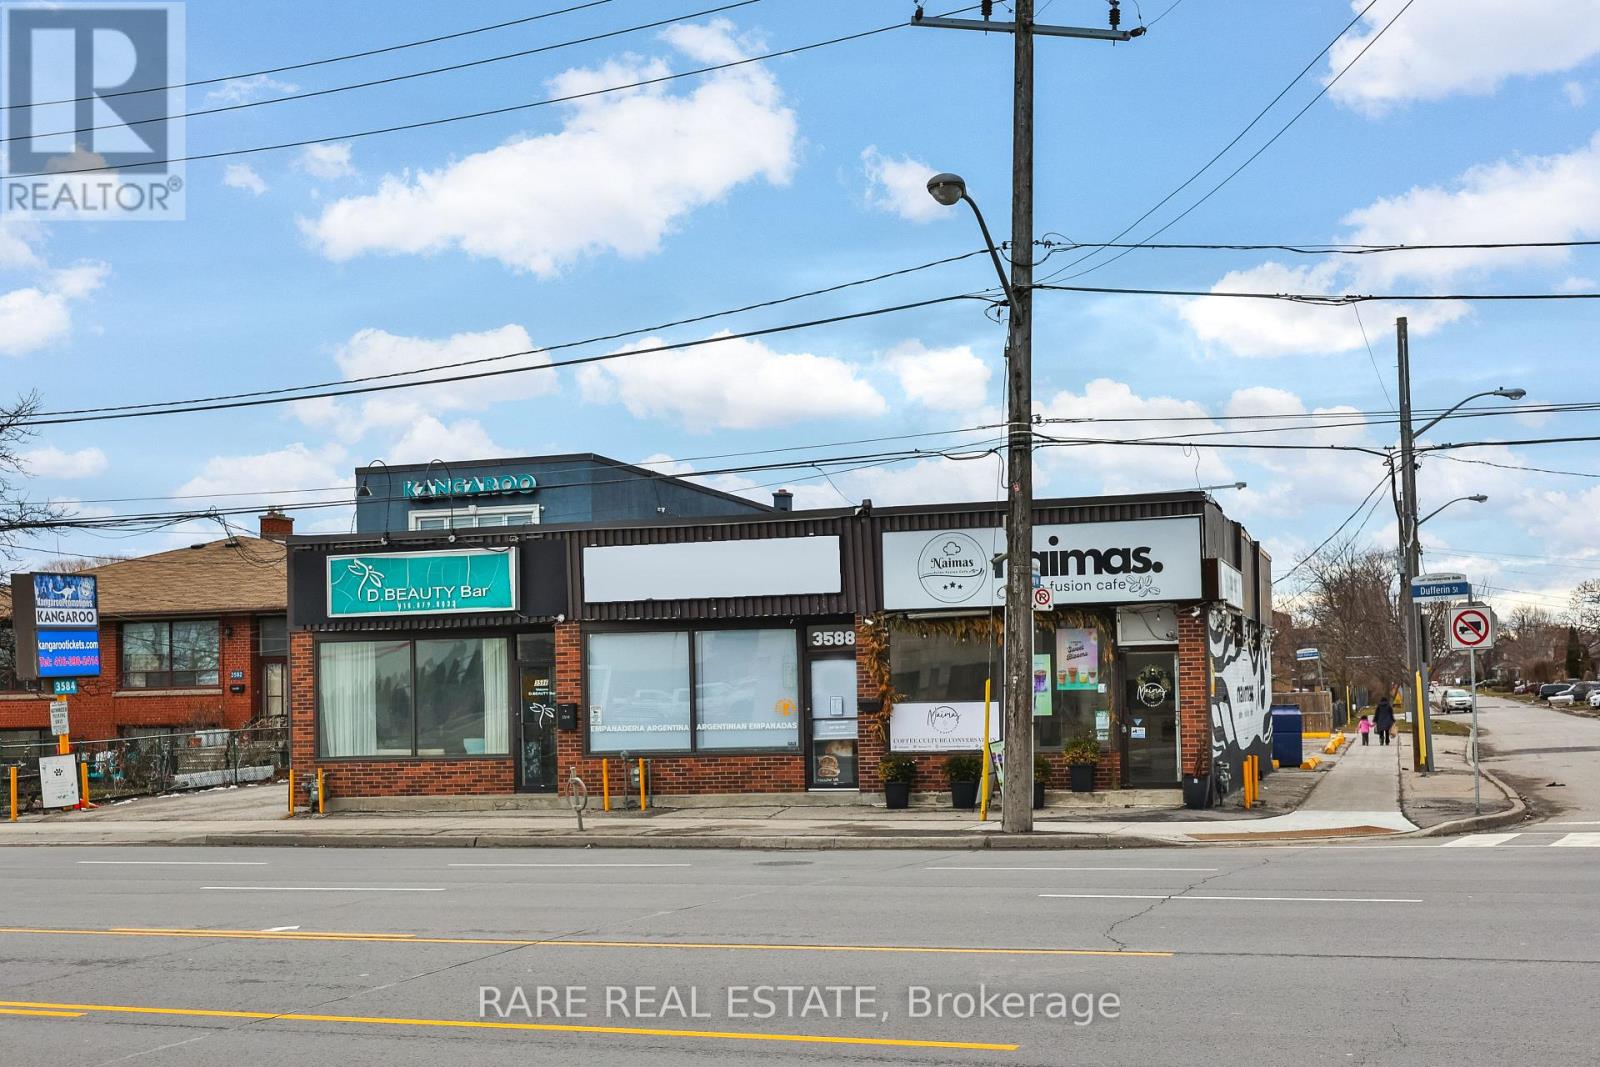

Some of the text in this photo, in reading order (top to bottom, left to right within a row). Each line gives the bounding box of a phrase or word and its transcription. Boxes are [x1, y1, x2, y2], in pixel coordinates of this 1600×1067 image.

[404, 474, 537, 497] KANGAROO
[930, 556, 974, 569] Naimas
[1050, 580, 1092, 592] fusion
[1096, 578, 1126, 591] cafe
[1420, 585, 1459, 596] Dufferin St
[367, 585, 489, 602] D.BEAUTY Bar
[37, 610, 94, 623] KANGAROO
[812, 631, 856, 646] 3588
[38, 640, 98, 652] kangarootickets.com
[55, 681, 76, 691] 3584
[696, 721, 798, 731] ARGENTINIAN EMPANADAS
